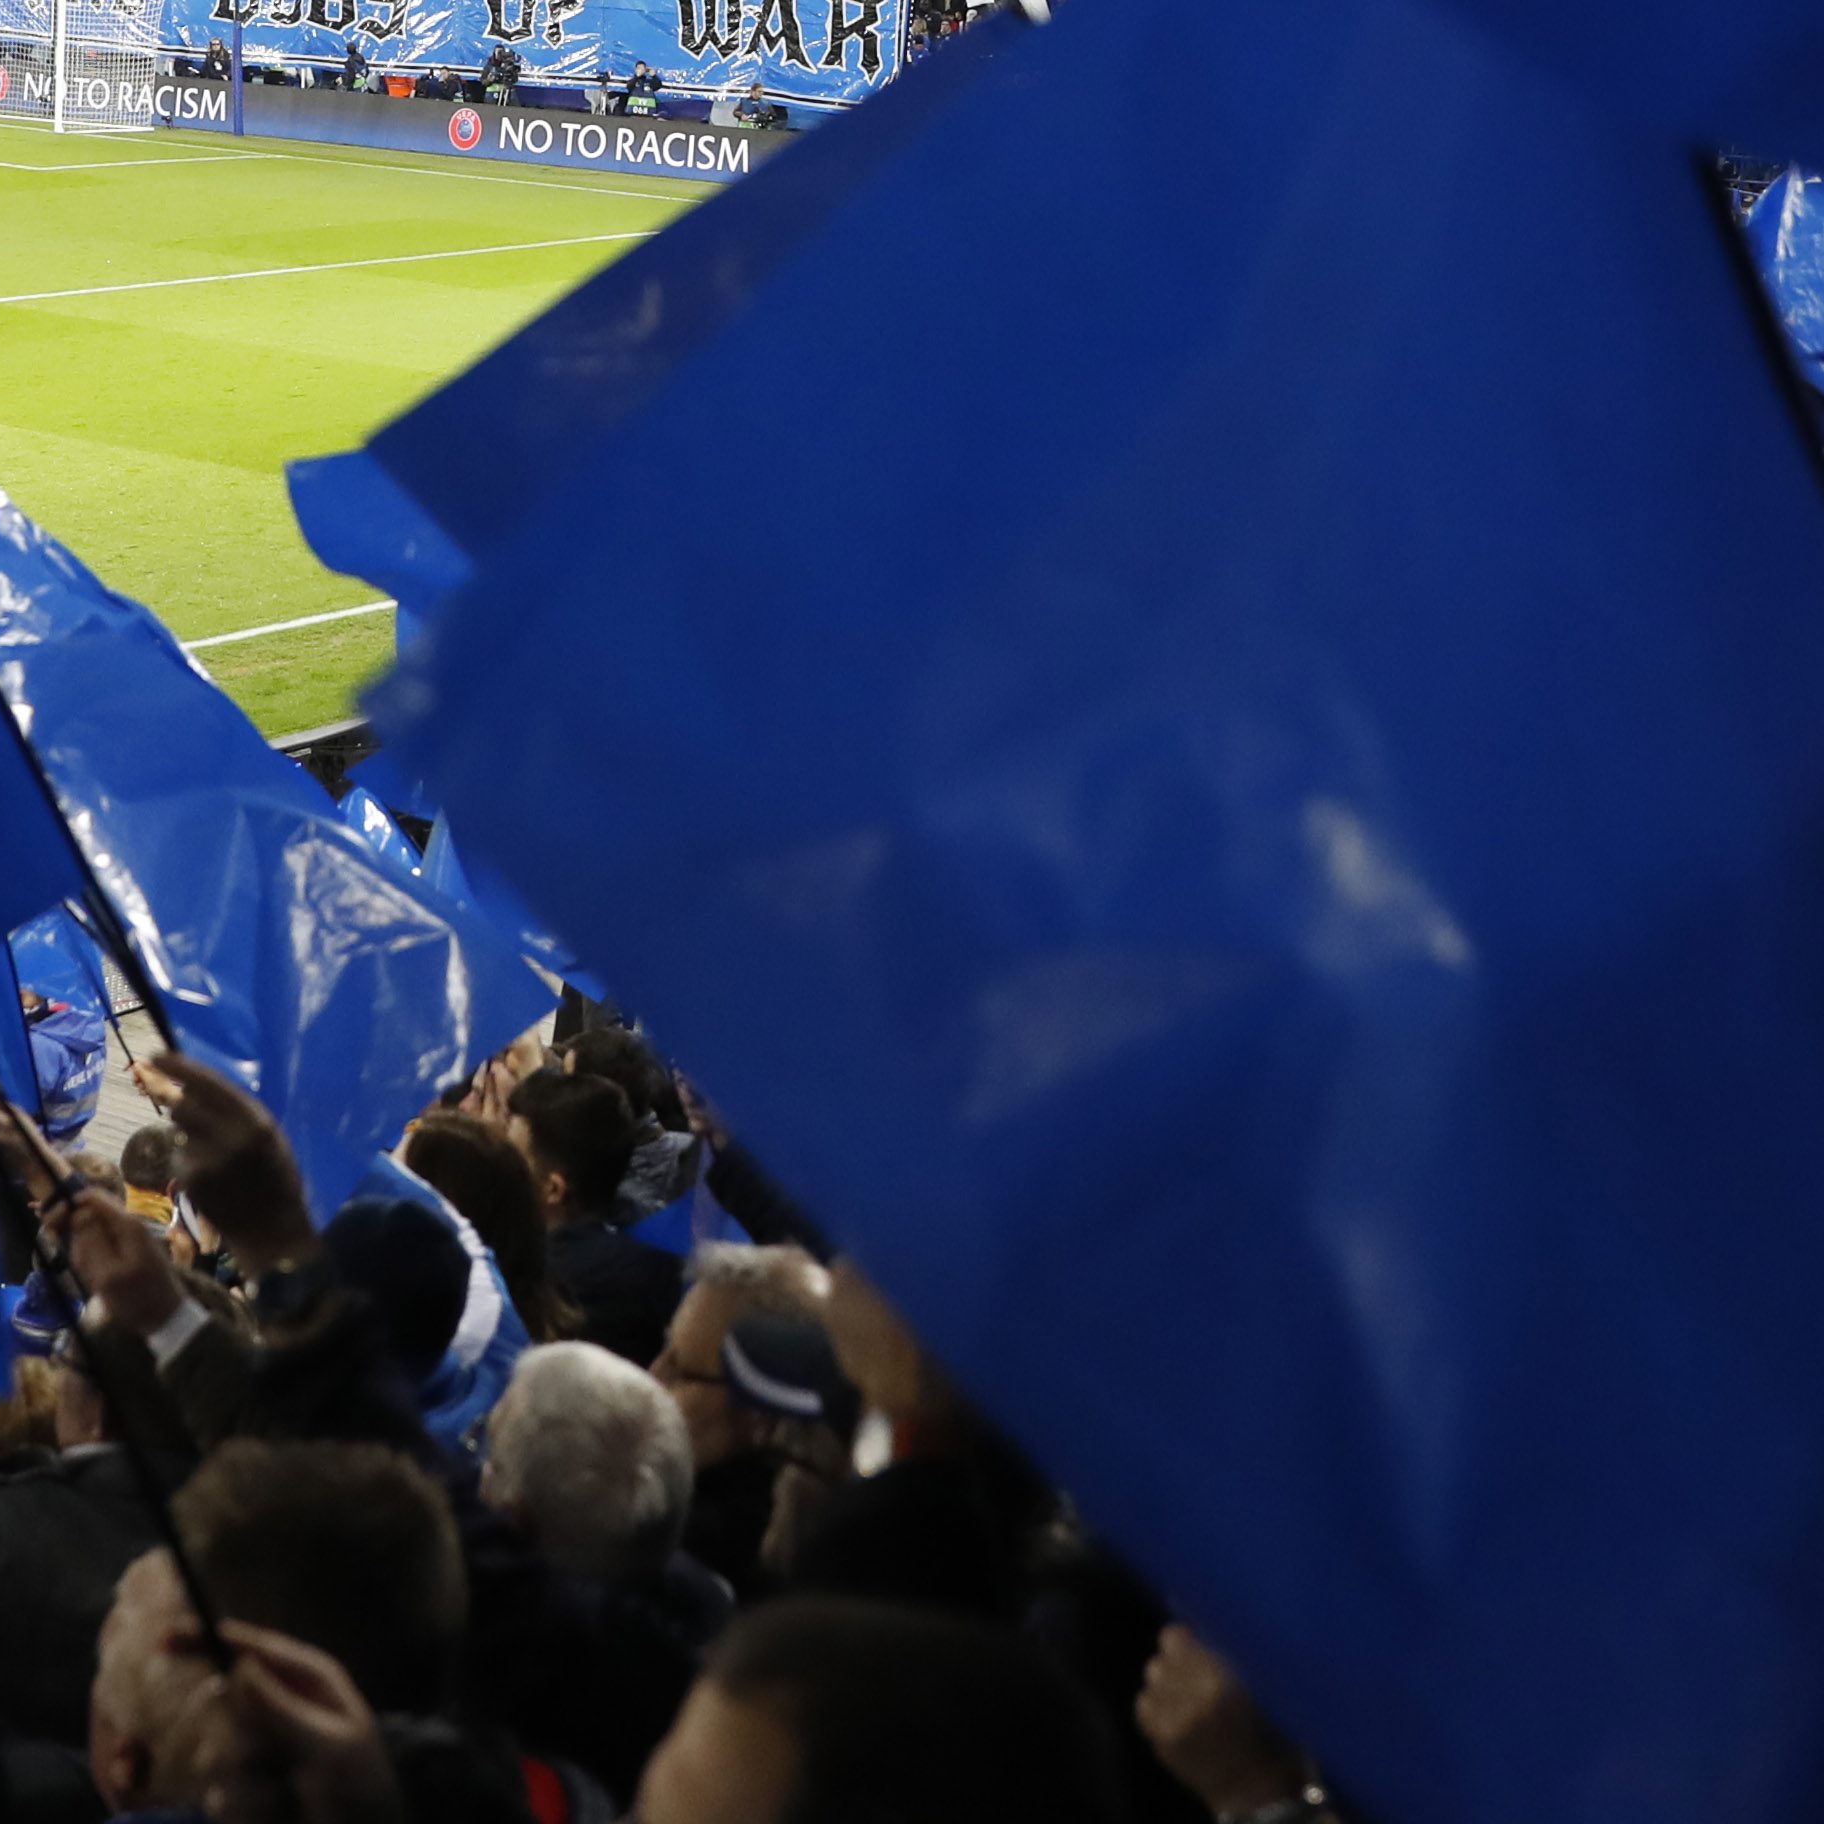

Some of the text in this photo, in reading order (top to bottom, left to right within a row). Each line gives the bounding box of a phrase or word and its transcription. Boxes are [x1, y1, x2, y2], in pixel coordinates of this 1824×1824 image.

[74, 77, 110, 109] TO
[117, 81, 226, 122] RACISM
[499, 116, 749, 174] NO TO RACISM
